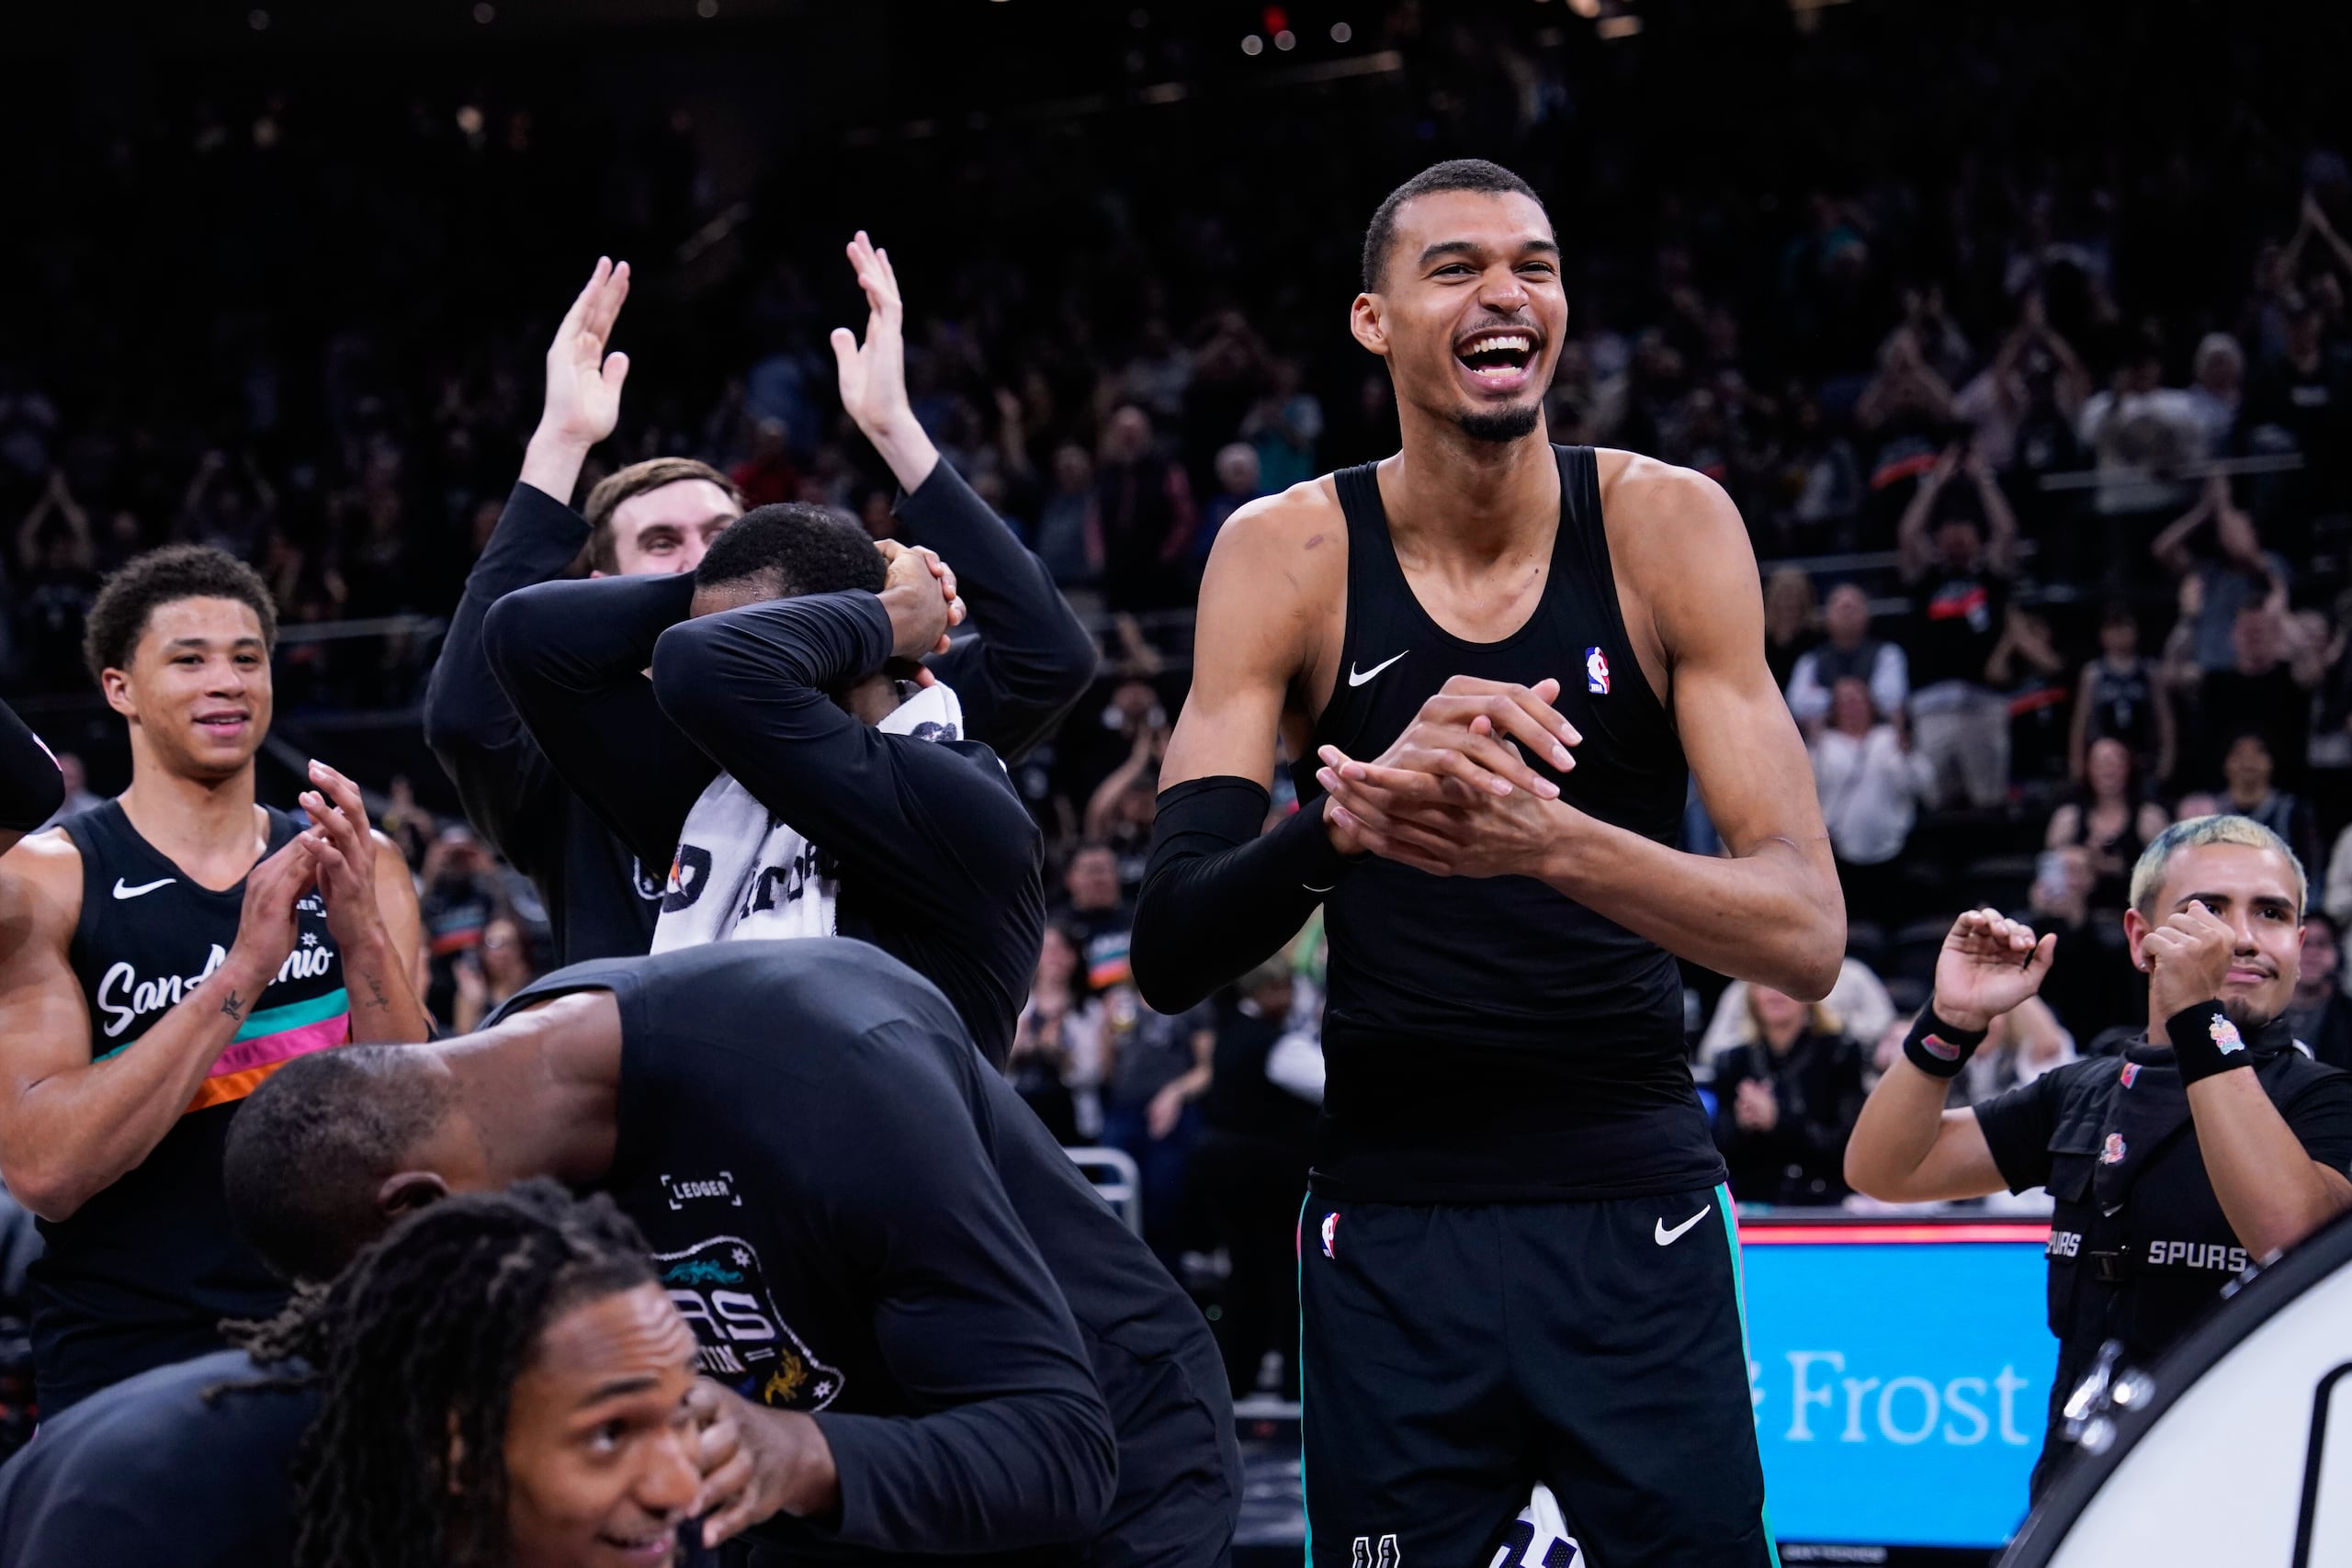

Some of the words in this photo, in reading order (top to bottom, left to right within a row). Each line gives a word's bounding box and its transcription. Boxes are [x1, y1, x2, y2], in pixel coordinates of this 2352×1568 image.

[96, 961, 185, 1038] San
[673, 1179, 730, 1200] LEDGER
[2045, 1231, 2083, 1258] PURS
[2147, 1240, 2248, 1273] SPURS
[1783, 1349, 2031, 1446] Frost
